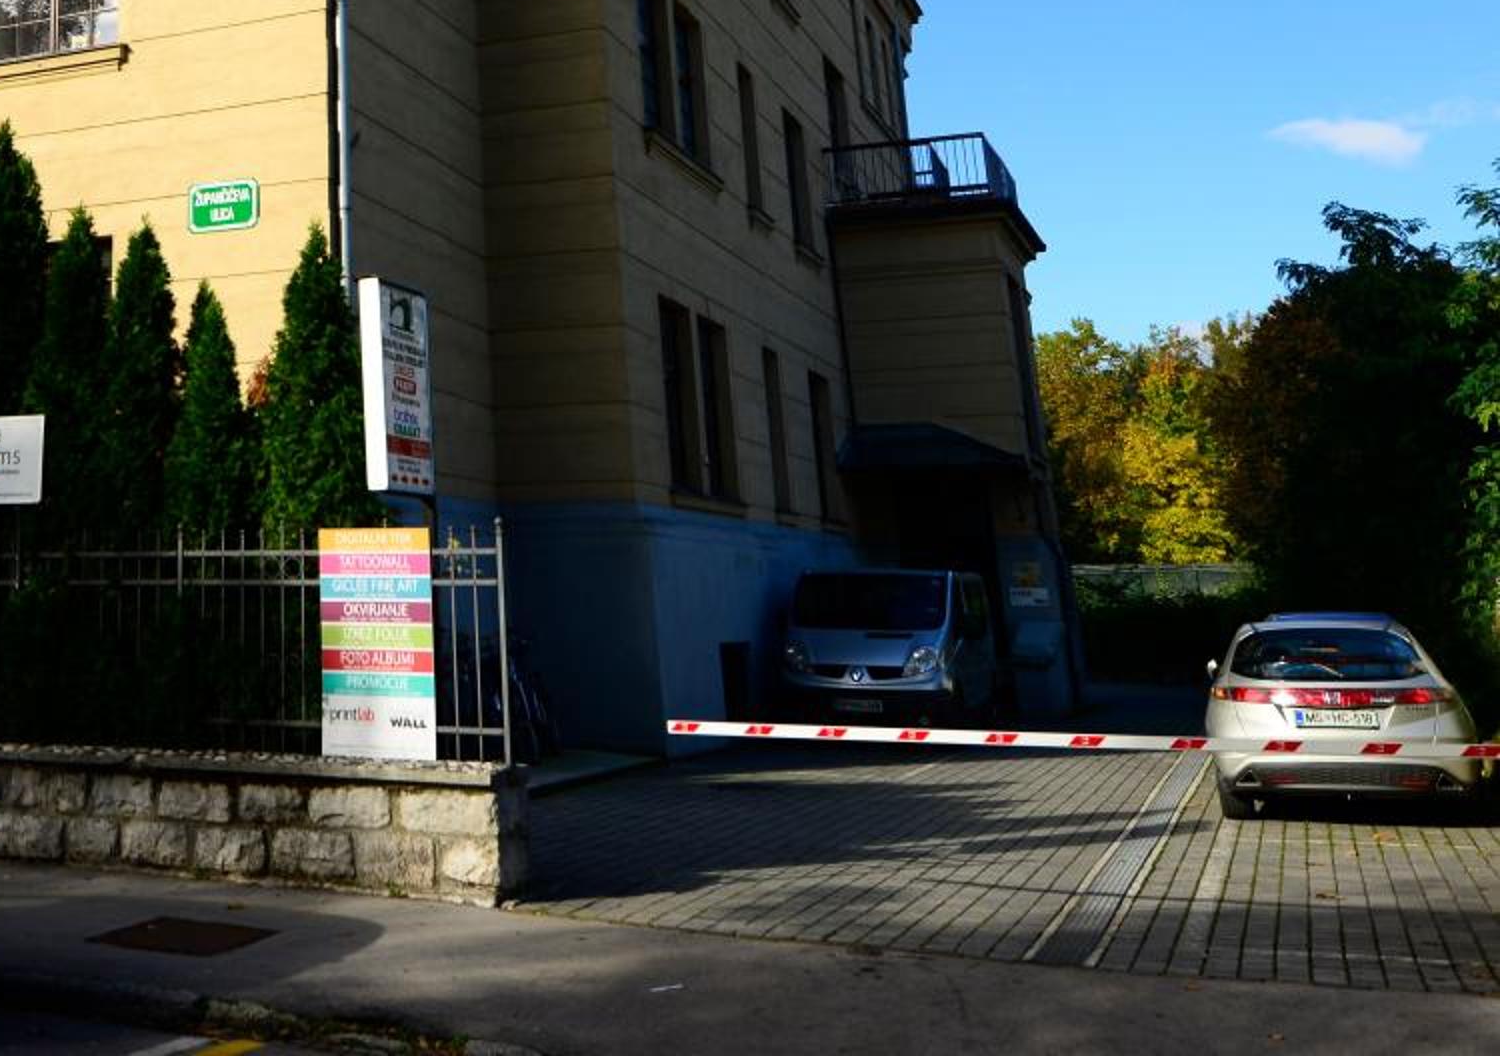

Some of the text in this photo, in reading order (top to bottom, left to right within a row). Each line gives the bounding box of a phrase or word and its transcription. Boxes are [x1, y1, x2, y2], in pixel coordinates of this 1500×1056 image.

[397, 579, 418, 592] ART
[343, 602, 409, 617] OKVIRJANJE
[340, 650, 370, 665] FOTO
[329, 706, 375, 724] printlab
[389, 716, 428, 729] WALL
